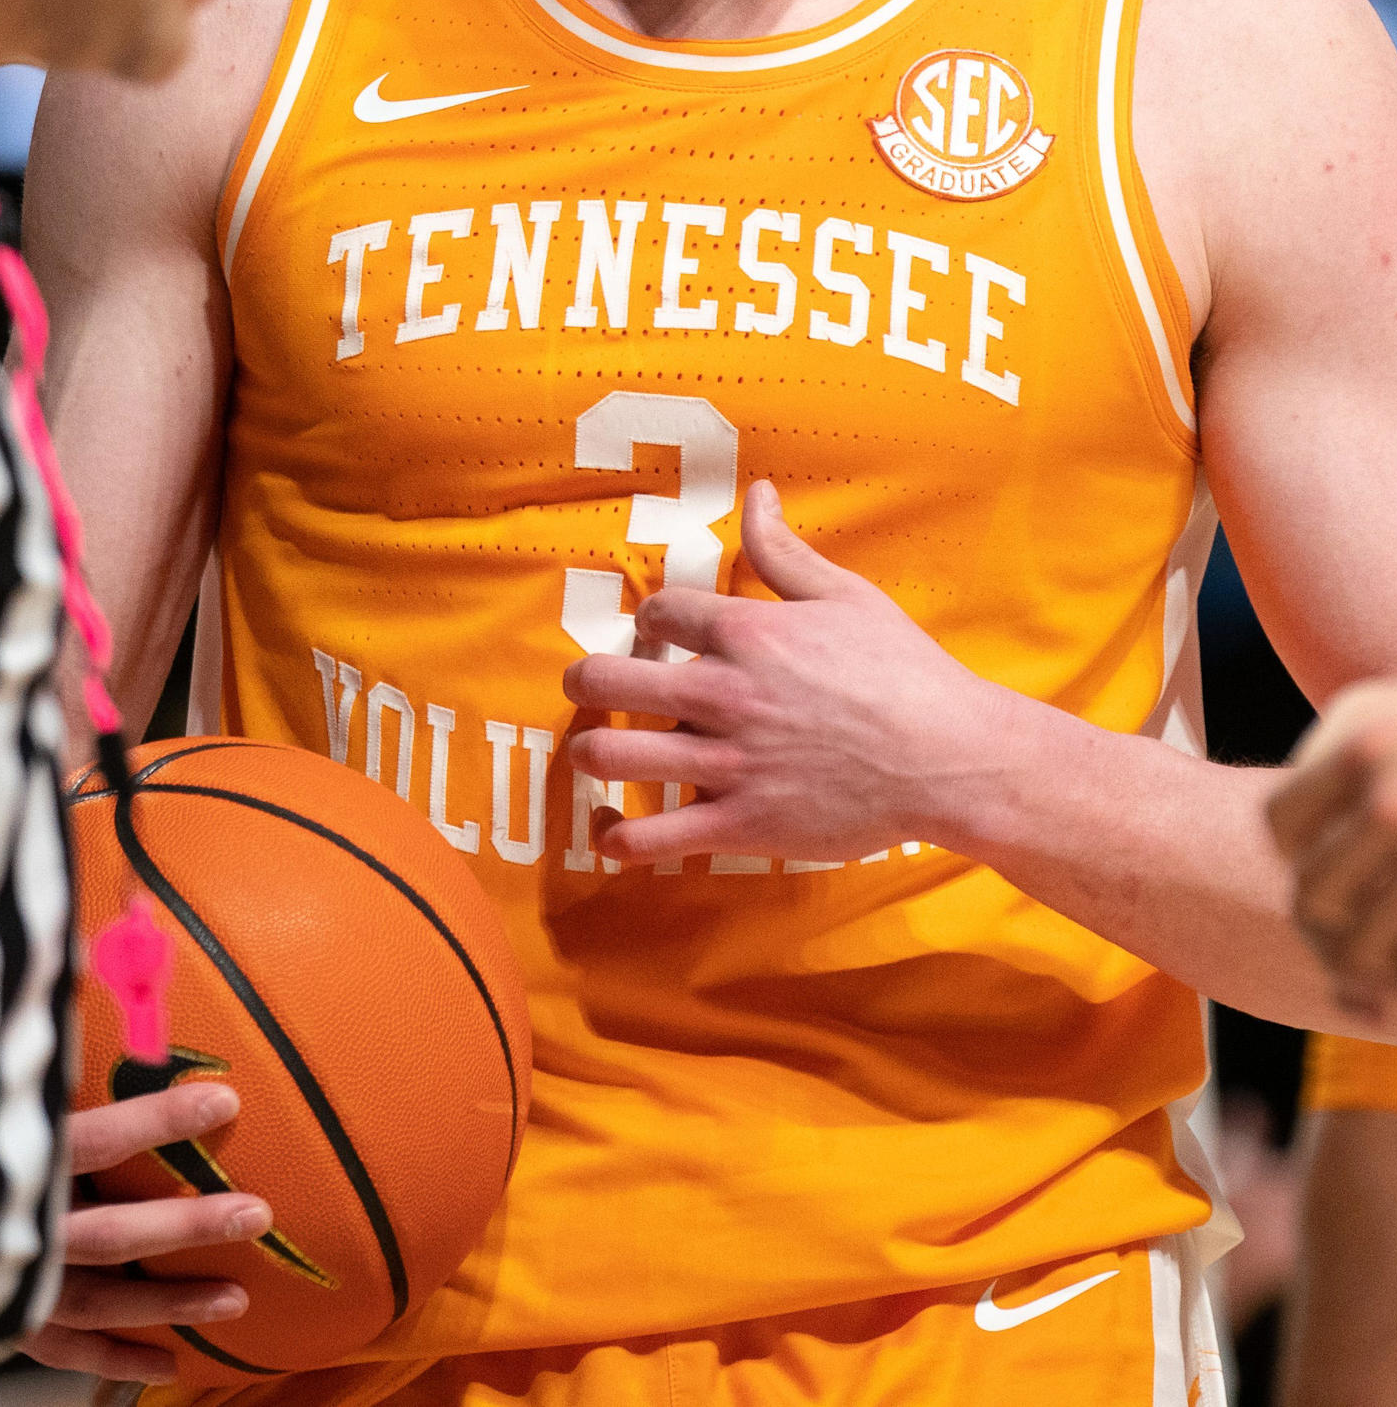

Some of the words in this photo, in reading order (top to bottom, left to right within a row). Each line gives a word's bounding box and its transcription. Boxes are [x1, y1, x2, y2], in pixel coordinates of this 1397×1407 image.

[890, 143, 1030, 194] GRADUATE
[912, 59, 1020, 157] SEC
[327, 200, 1027, 406] TENNESSEE
[562, 391, 739, 664] 3
